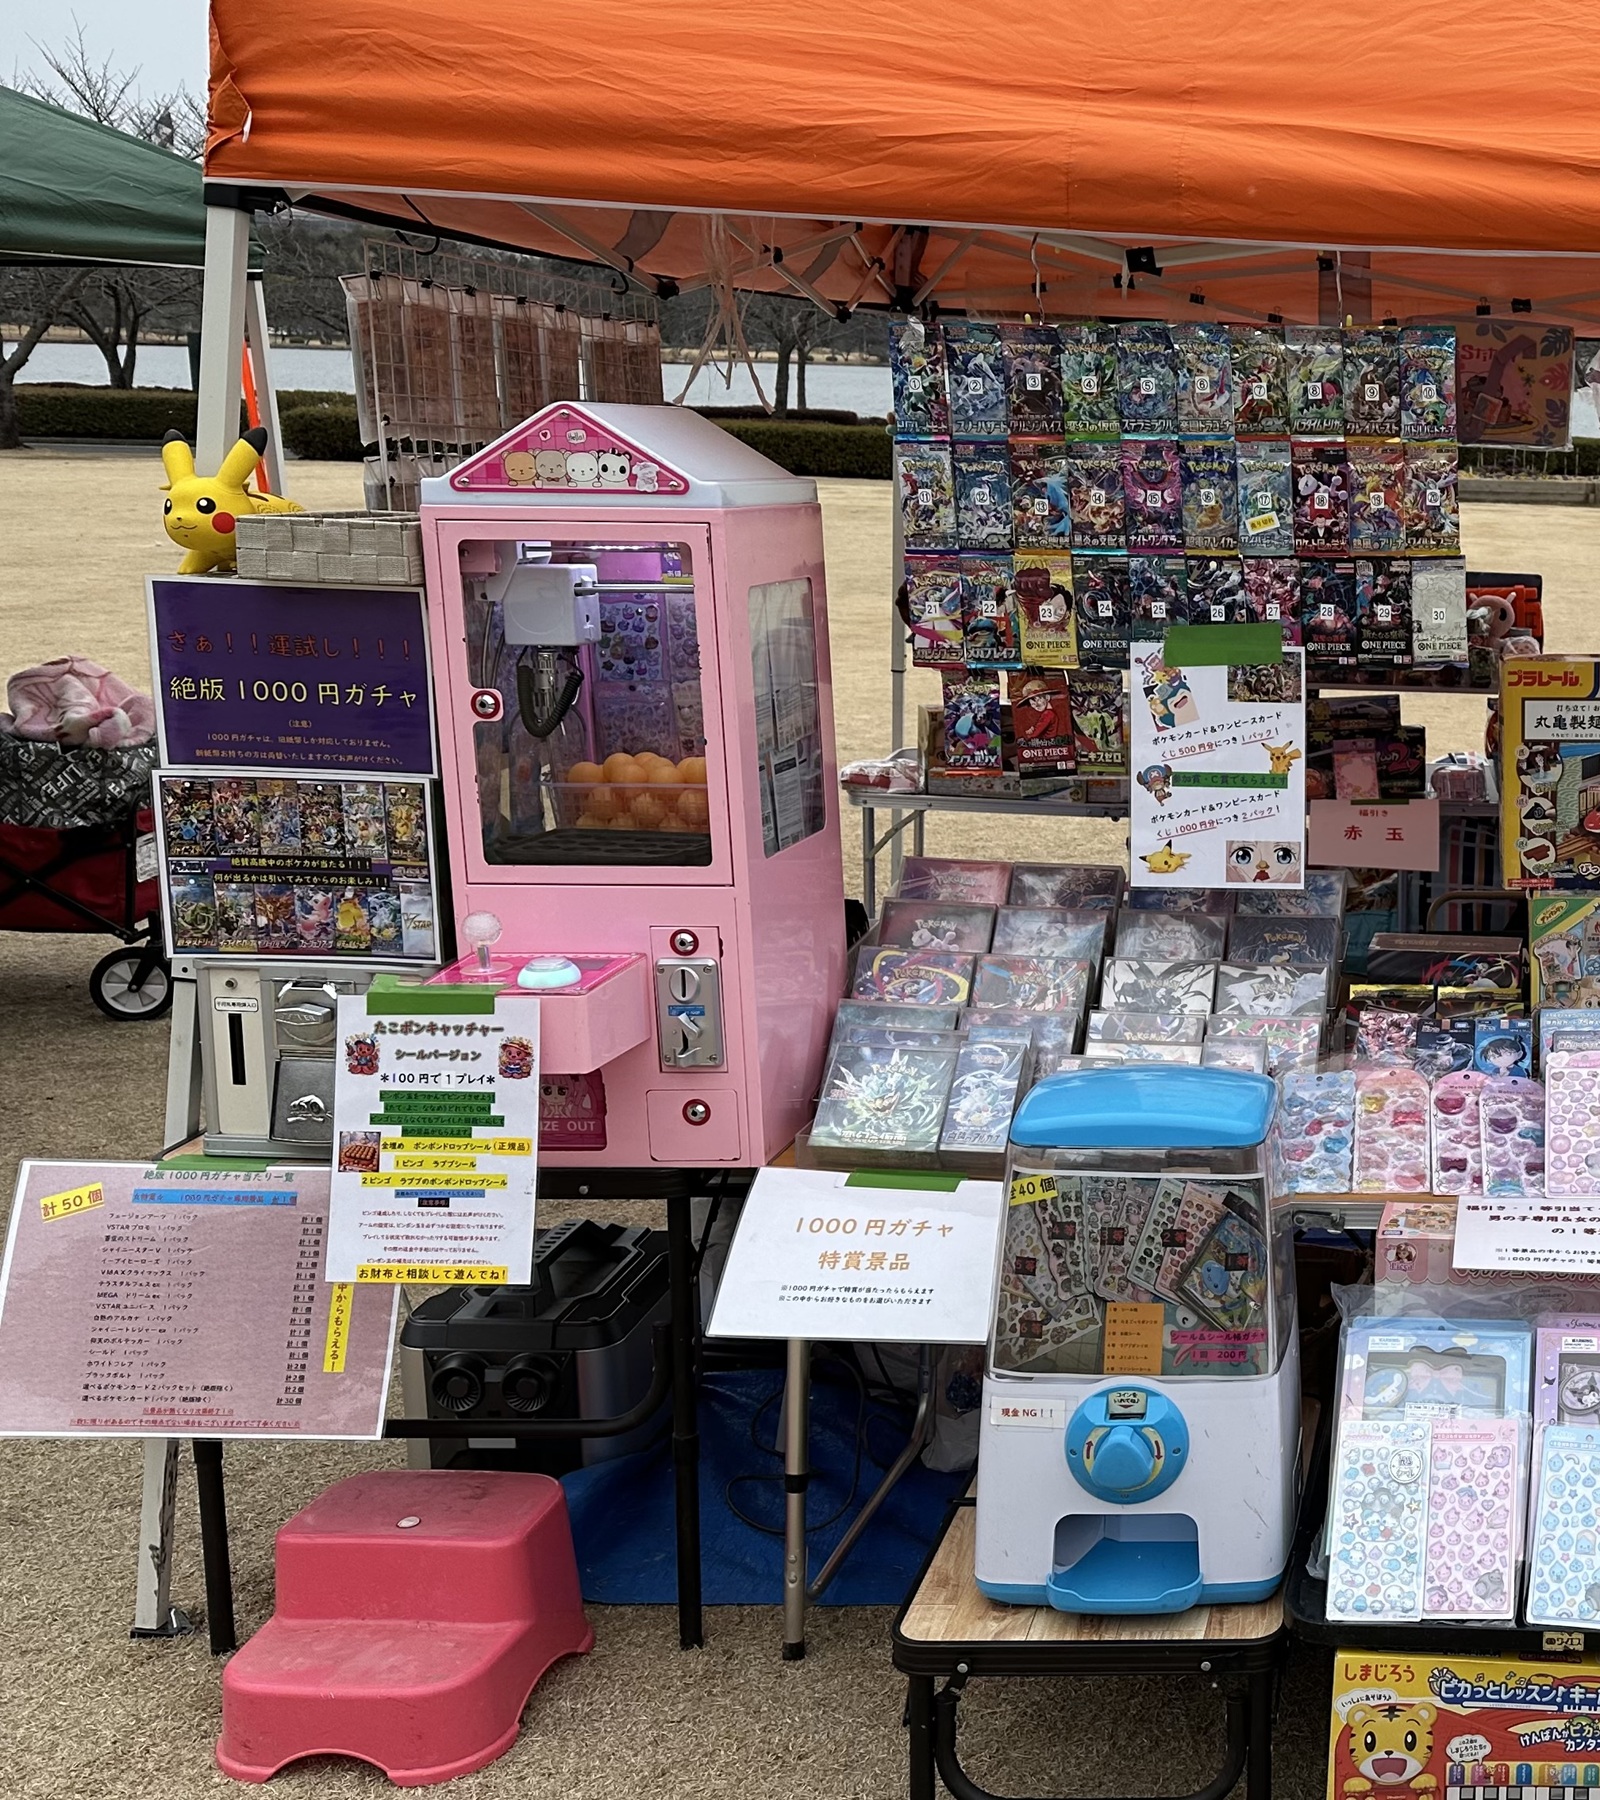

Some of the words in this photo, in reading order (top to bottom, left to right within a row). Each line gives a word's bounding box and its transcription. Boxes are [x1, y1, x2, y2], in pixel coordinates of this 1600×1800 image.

[567, 432, 586, 442] Hello!
[927, 604, 938, 613] 21
[984, 603, 995, 613] 22
[1041, 607, 1053, 618] 23
[1099, 603, 1111, 613] 24
[1152, 605, 1164, 614] 25
[1268, 607, 1279, 616] 27
[1321, 606, 1334, 617] 28
[1379, 607, 1391, 618] 29
[1212, 608, 1223, 618] 26
[1433, 611, 1445, 620] 30
[1046, 640, 1071, 649] PIECE
[1103, 640, 1128, 648] PIECE
[1328, 642, 1351, 651] PIECE
[1382, 641, 1406, 649] PIECE
[1437, 642, 1462, 650] PIECE
[1507, 670, 1583, 688] プラレール
[1043, 748, 1069, 757] PIECE
[1359, 809, 1388, 817] 福引き
[567, 1120, 596, 1132] OUT
[818, 1250, 911, 1272] 特賞景品
[1343, 1664, 1416, 1682] しまじろう
